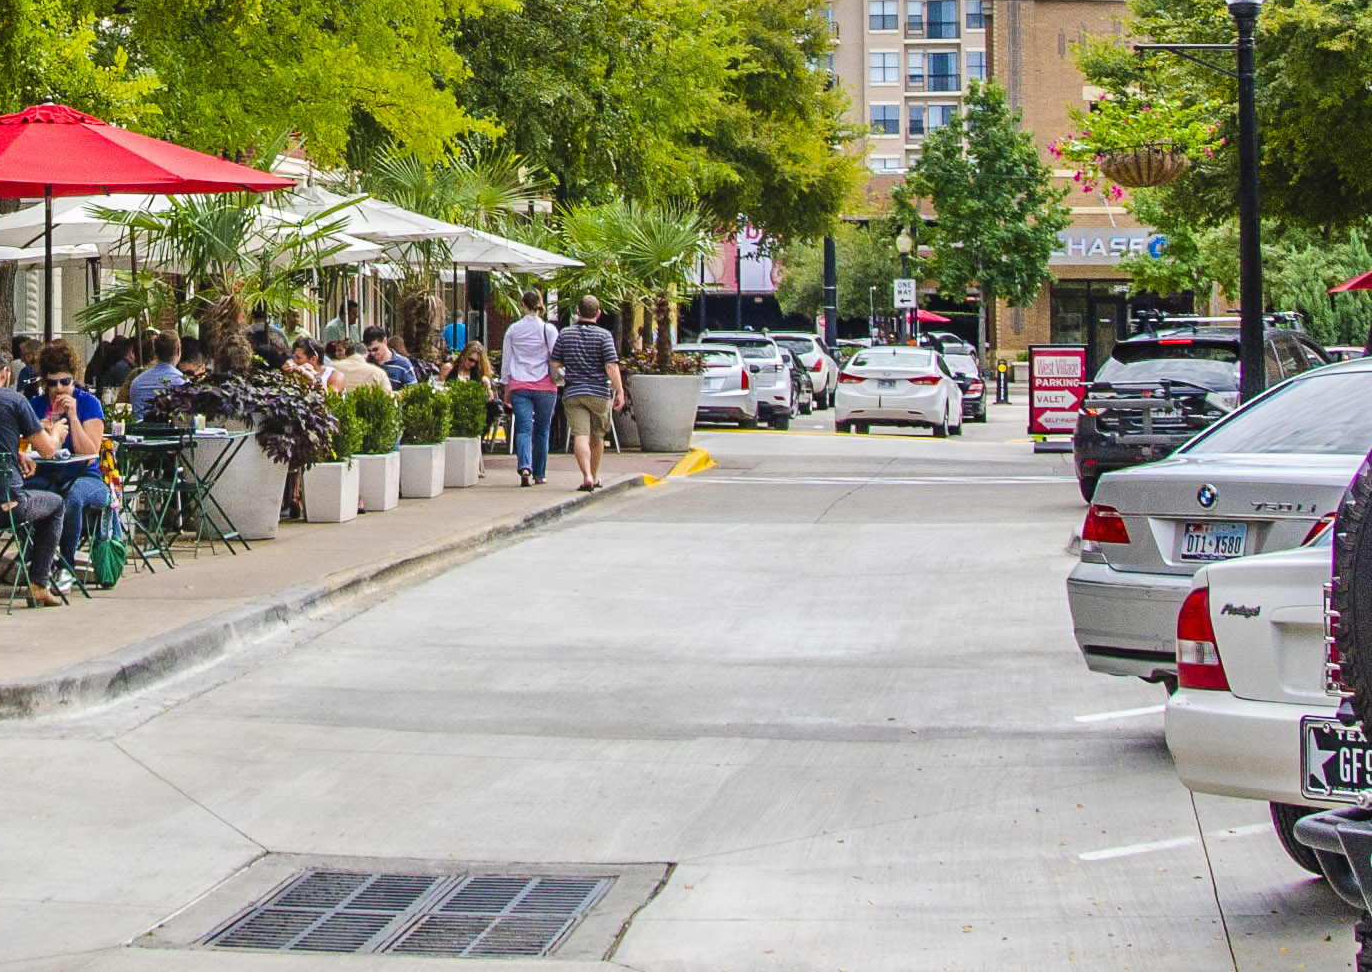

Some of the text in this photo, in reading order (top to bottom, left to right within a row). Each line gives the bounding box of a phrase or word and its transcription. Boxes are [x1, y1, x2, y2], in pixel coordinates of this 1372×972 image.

[1050, 235, 1146, 258] CHASE
[897, 281, 913, 289] ONE
[1036, 358, 1079, 376] West Village
[1035, 378, 1081, 387] PARKING
[1036, 395, 1067, 403] VALET
